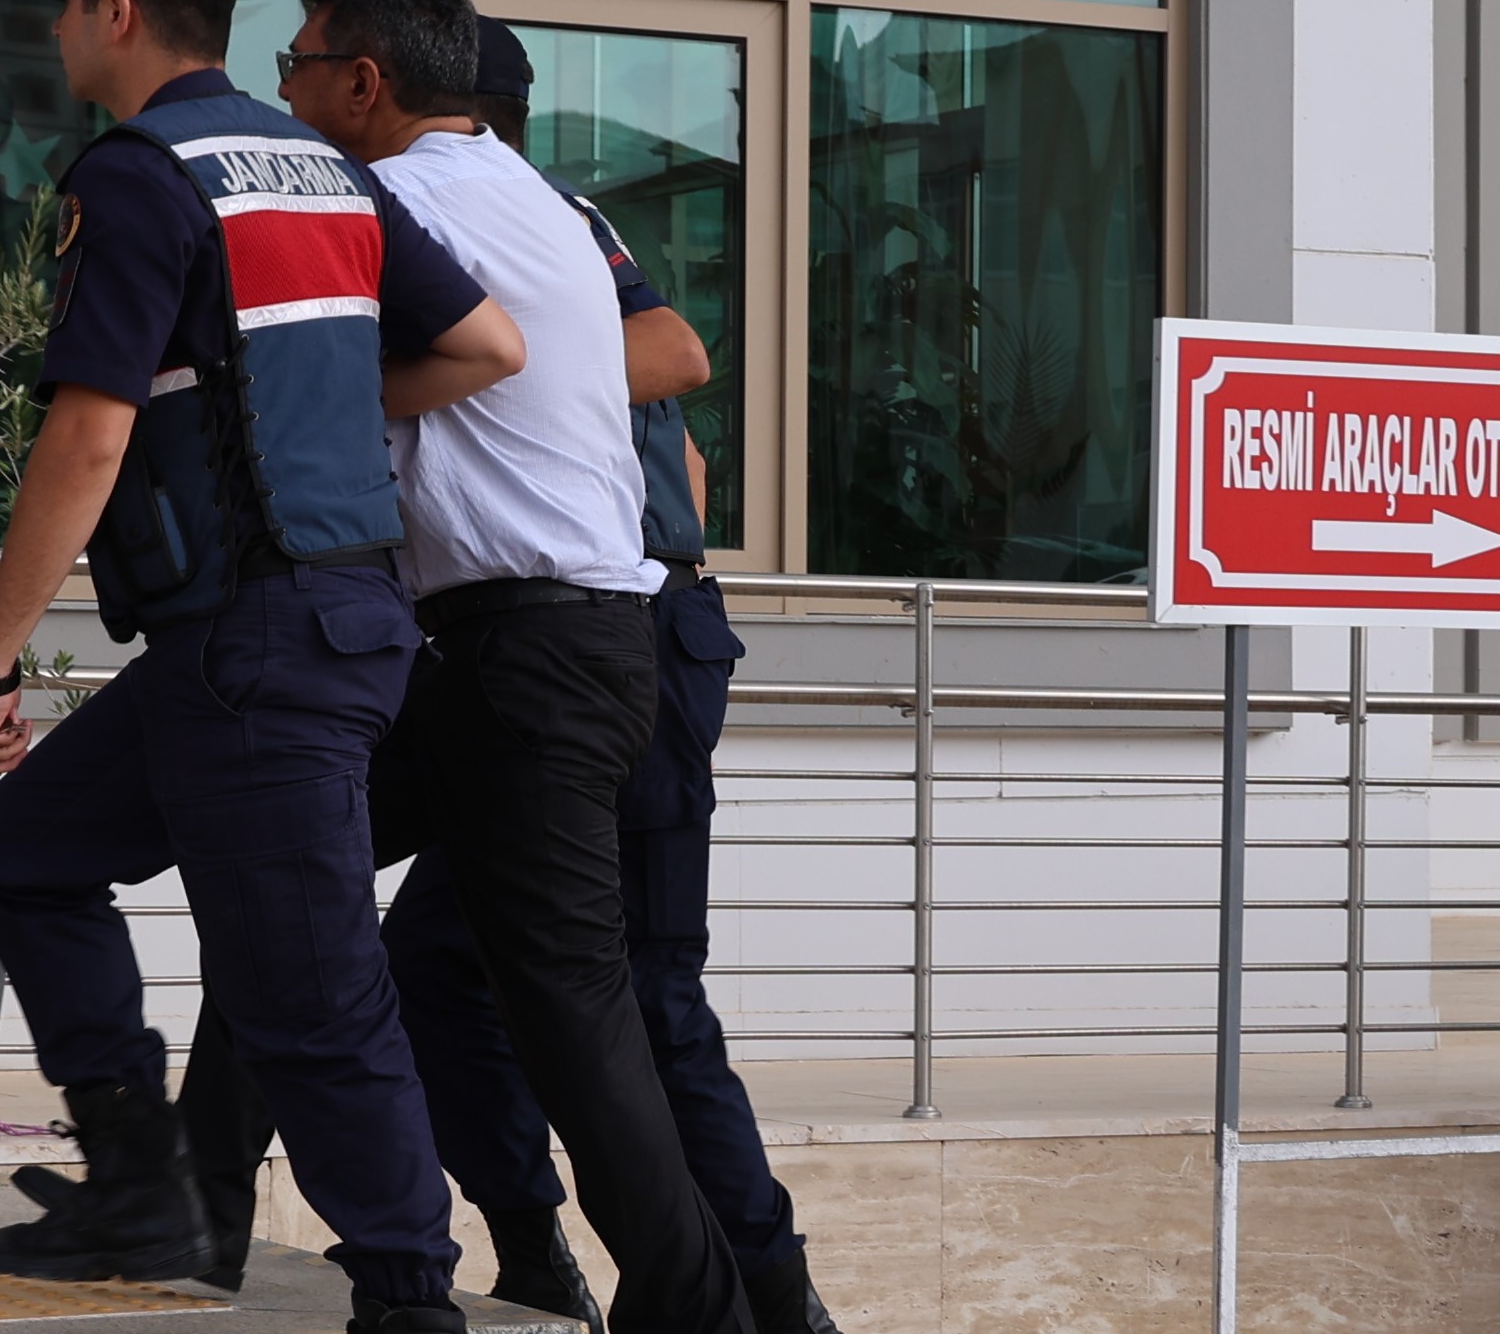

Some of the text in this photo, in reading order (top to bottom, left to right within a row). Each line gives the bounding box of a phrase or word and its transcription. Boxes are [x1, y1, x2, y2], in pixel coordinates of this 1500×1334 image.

[215, 152, 360, 195] JANDARMA
[1222, 390, 1315, 491] RESMİ
[1321, 411, 1458, 517] ARAÇLAR
